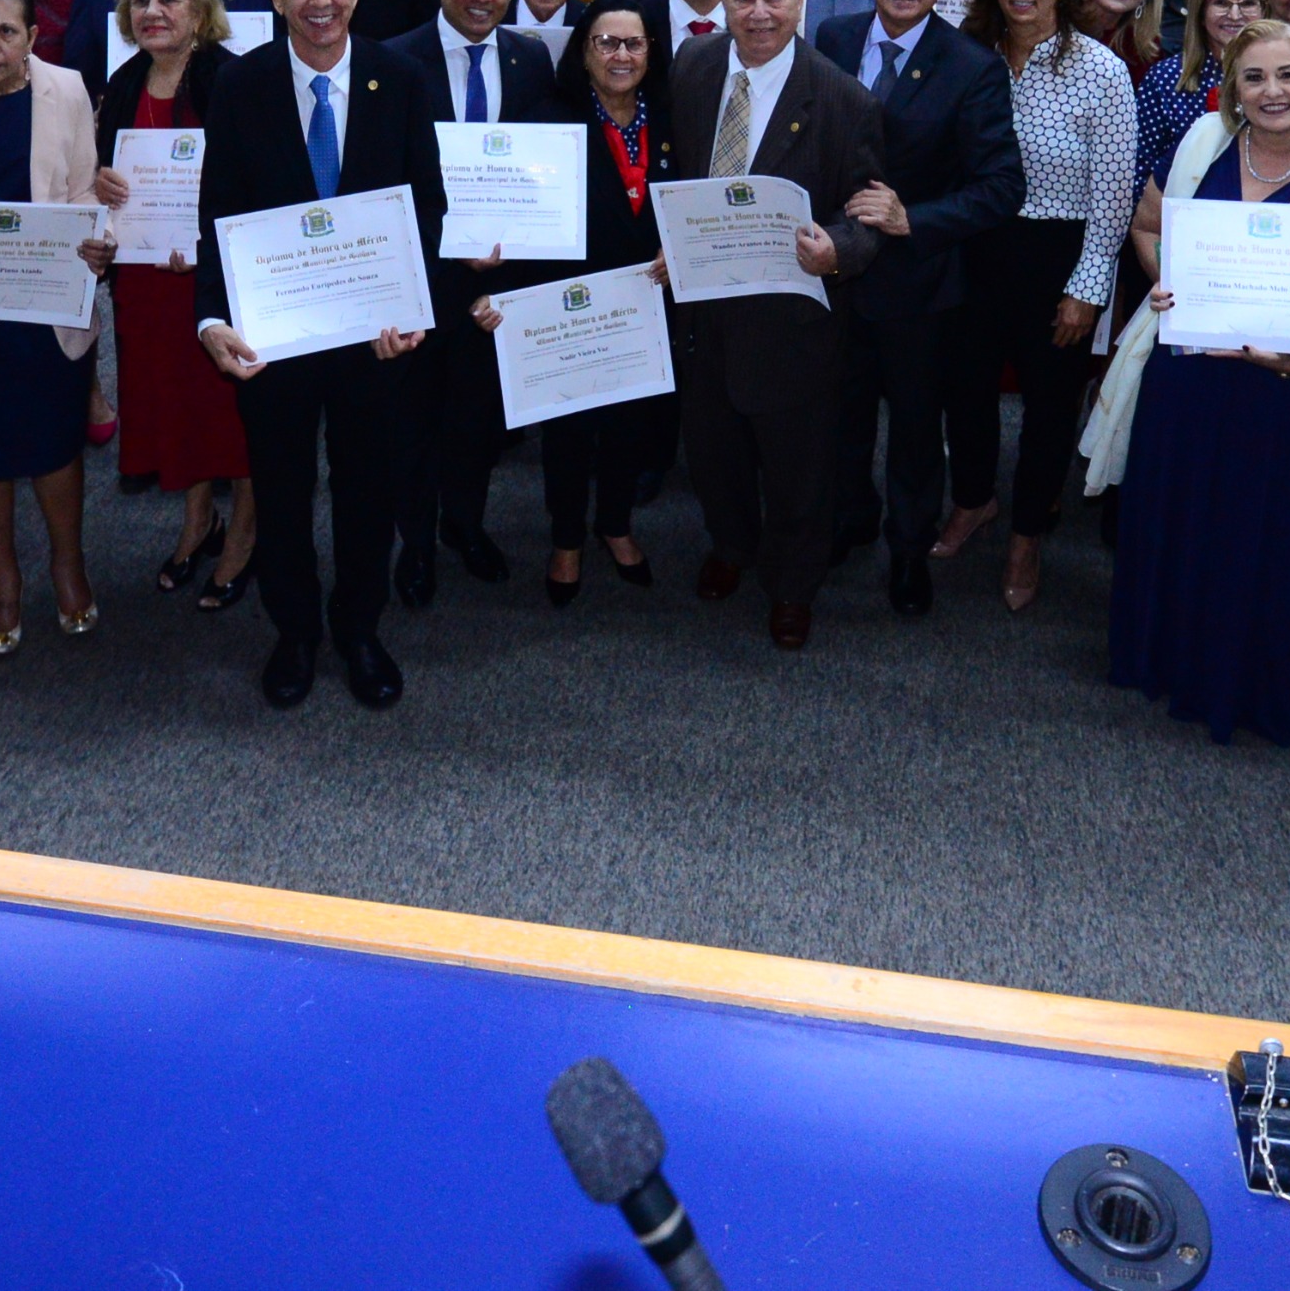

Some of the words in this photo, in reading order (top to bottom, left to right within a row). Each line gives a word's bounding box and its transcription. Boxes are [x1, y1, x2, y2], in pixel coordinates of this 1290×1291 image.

[474, 164, 482, 173] de
[487, 164, 512, 173] Honra
[686, 217, 720, 225] Diploma
[735, 213, 761, 221] Honra
[776, 213, 800, 223] Mérito
[24, 239, 35, 247] ao
[39, 239, 70, 248] Mérito
[255, 250, 294, 265] Diploma
[297, 249, 306, 258] de
[311, 243, 339, 255] Honra
[342, 241, 353, 250] ao
[357, 236, 388, 248] Mérito
[1196, 241, 1233, 253] Diploma
[1238, 243, 1248, 254] de
[1252, 244, 1281, 255] Honra
[270, 262, 299, 274] Câmara
[302, 256, 337, 268] Municipal
[349, 250, 376, 260] Goiânia
[275, 284, 309, 296] Fernando
[348, 276, 356, 284] de
[1208, 281, 1231, 290] Eliana
[1234, 283, 1267, 292] Machado
[1270, 285, 1288, 293] Melo
[524, 323, 557, 338] Diploma
[560, 321, 568, 330] de
[571, 316, 596, 328] Honra
[599, 313, 608, 322] ao
[611, 308, 638, 319] Mérito
[536, 334, 561, 345] Câmara
[564, 328, 593, 339] Municipal
[604, 321, 627, 331] Goiânia
